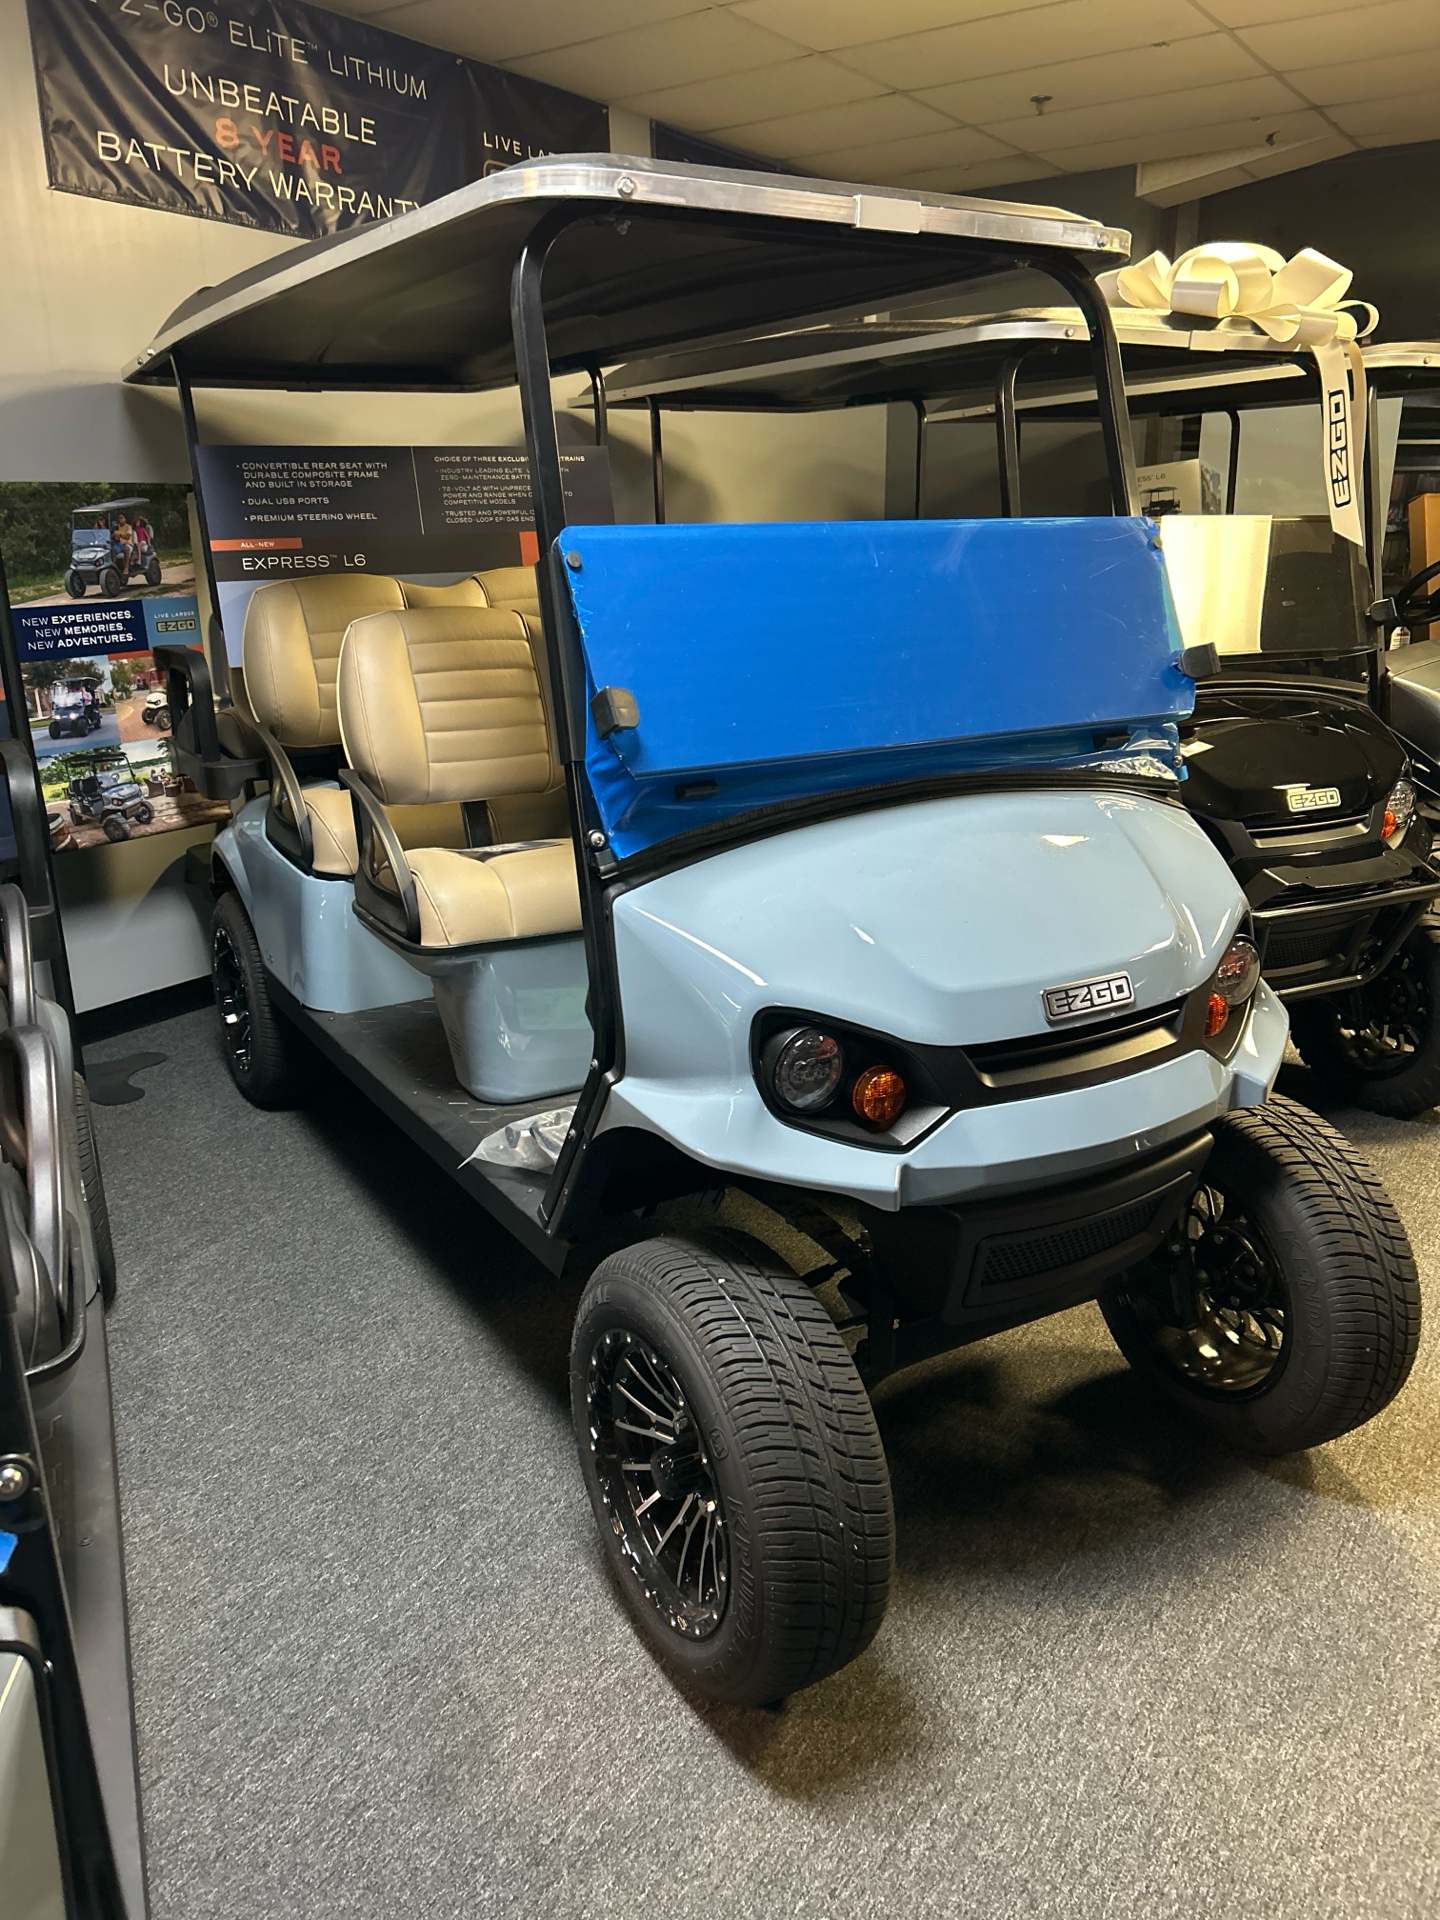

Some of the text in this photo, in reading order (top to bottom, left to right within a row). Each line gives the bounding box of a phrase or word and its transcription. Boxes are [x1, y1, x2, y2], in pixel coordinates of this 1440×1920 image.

[327, 50, 427, 100] LITHIUM
[164, 64, 377, 145] UNBEATABLE
[215, 117, 342, 174] 8 YEAR
[483, 132, 522, 156] LIVE
[97, 130, 420, 218] BATTERY WARRANT
[1329, 390, 1350, 507] EZGO
[242, 462, 310, 470] CONVERTIBLE
[311, 462, 337, 470] REAR
[243, 471, 289, 479] DURABLE
[309, 480, 353, 488] STORAGE
[250, 514, 294, 522] PREMIUM
[296, 513, 344, 521] STEERING
[343, 553, 367, 567] L6
[22, 610, 135, 627] NEW EXPERIENCES.
[157, 620, 196, 632] EZGO
[35, 623, 127, 638] NEW MEMORIES.
[27, 633, 137, 651] NEW ADVENTURES.
[1290, 790, 1339, 810] EZGO
[1047, 977, 1131, 1016] EZGO
